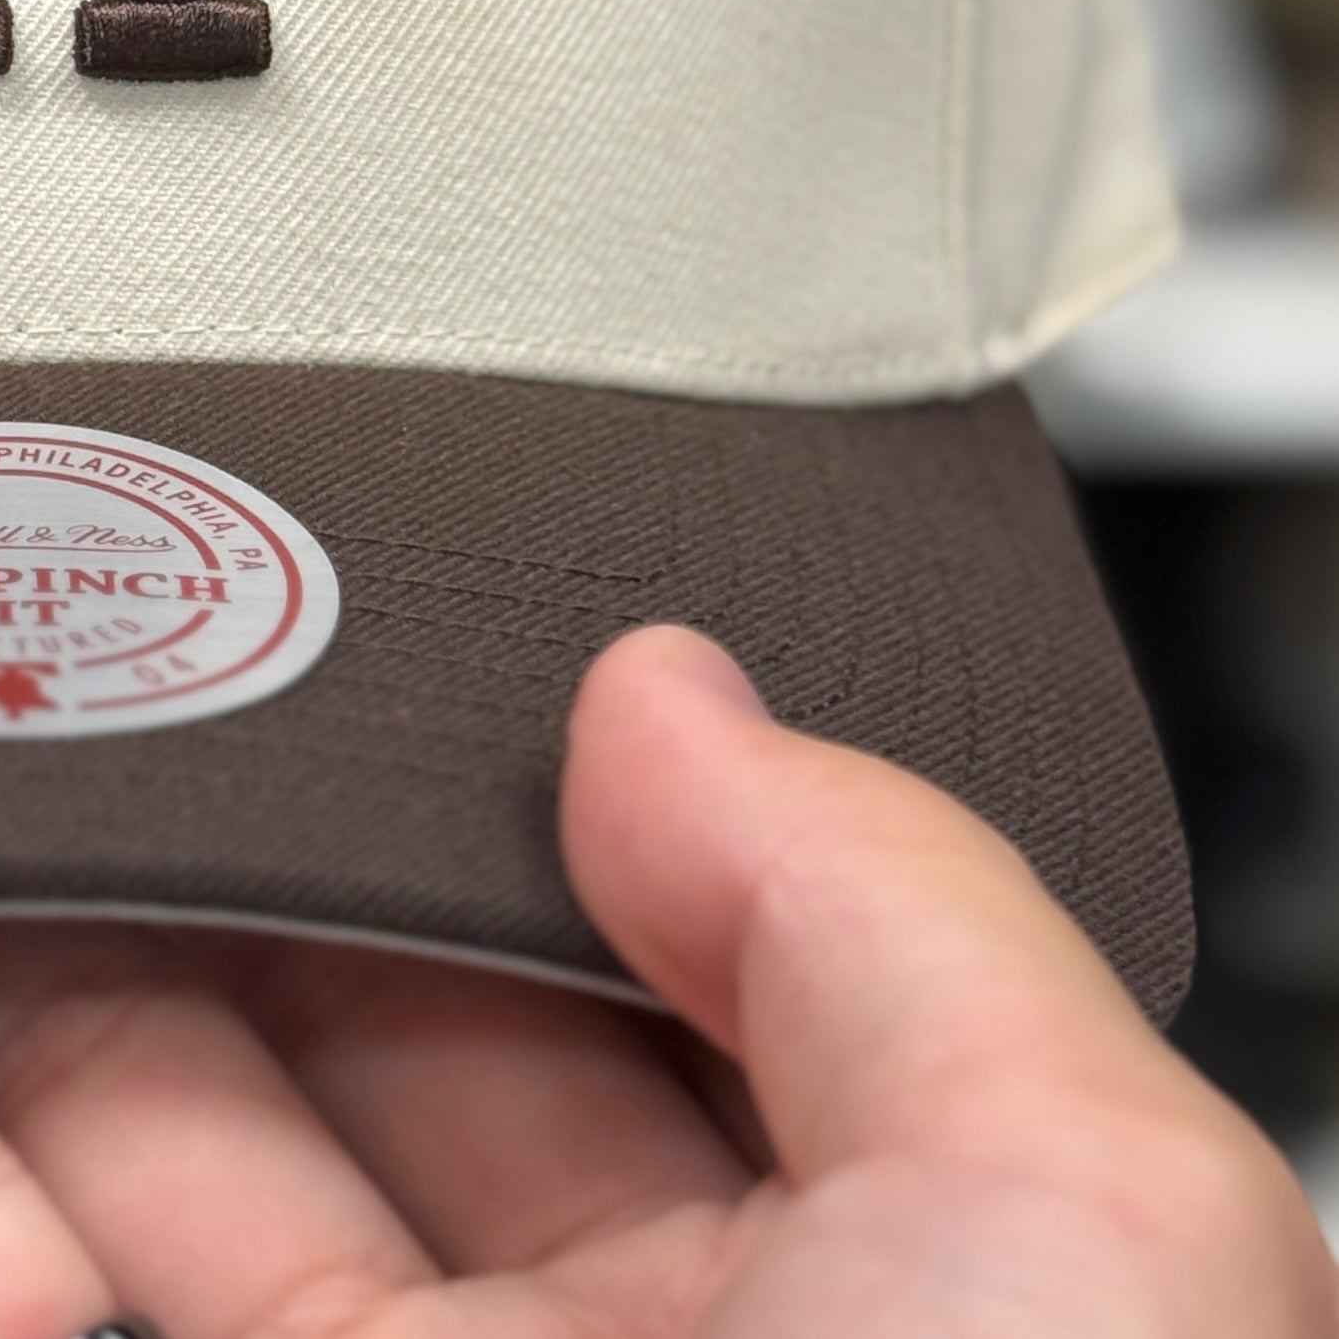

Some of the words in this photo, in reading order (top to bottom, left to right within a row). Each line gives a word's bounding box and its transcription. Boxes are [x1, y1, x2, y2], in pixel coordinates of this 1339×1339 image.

[26, 526, 58, 544] &
[66, 524, 177, 550] Ness
[228, 548, 270, 572] PA
